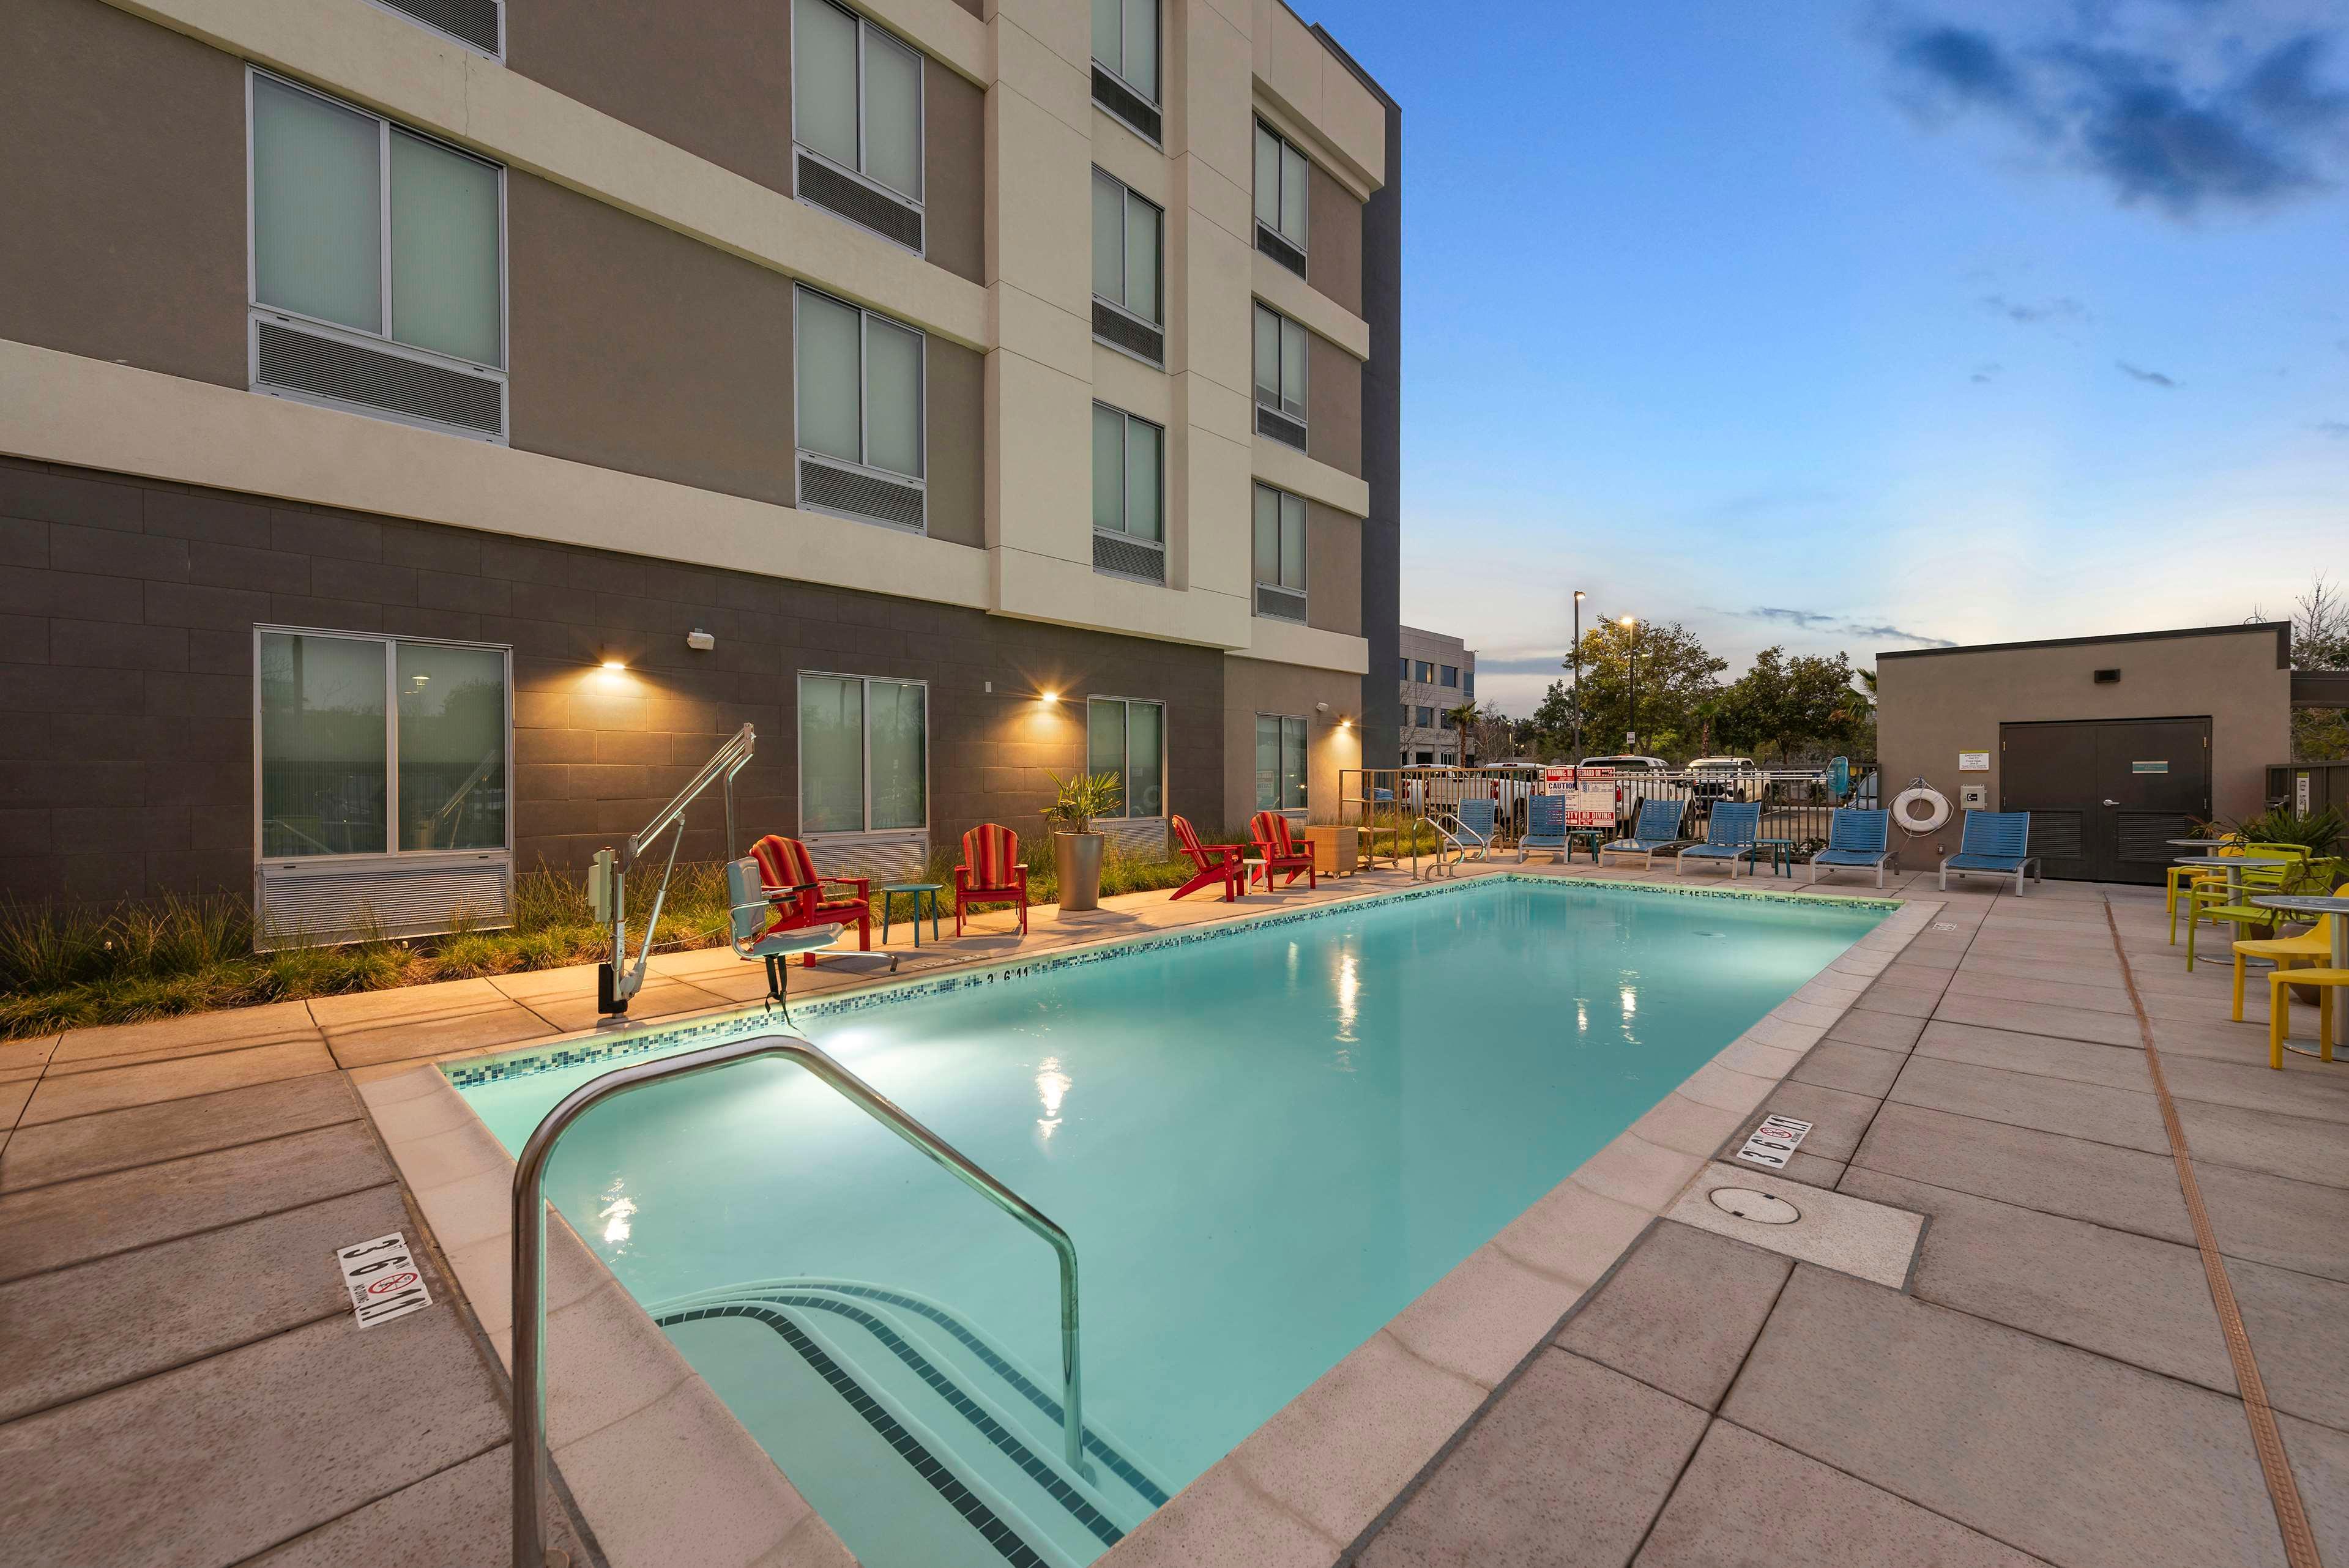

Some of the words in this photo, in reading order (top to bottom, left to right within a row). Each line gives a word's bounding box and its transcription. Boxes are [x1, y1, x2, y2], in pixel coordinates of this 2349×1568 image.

[1003, 970, 1010, 981] 6
[1751, 1139, 1791, 1151] 6
[1742, 1151, 1783, 1163] 3
[343, 1239, 400, 1259] 3
[349, 1256, 408, 1276] 6
[354, 1283, 366, 1291] NO
[355, 1289, 370, 1304] DIVING
[359, 1288, 426, 1321] 1.1
